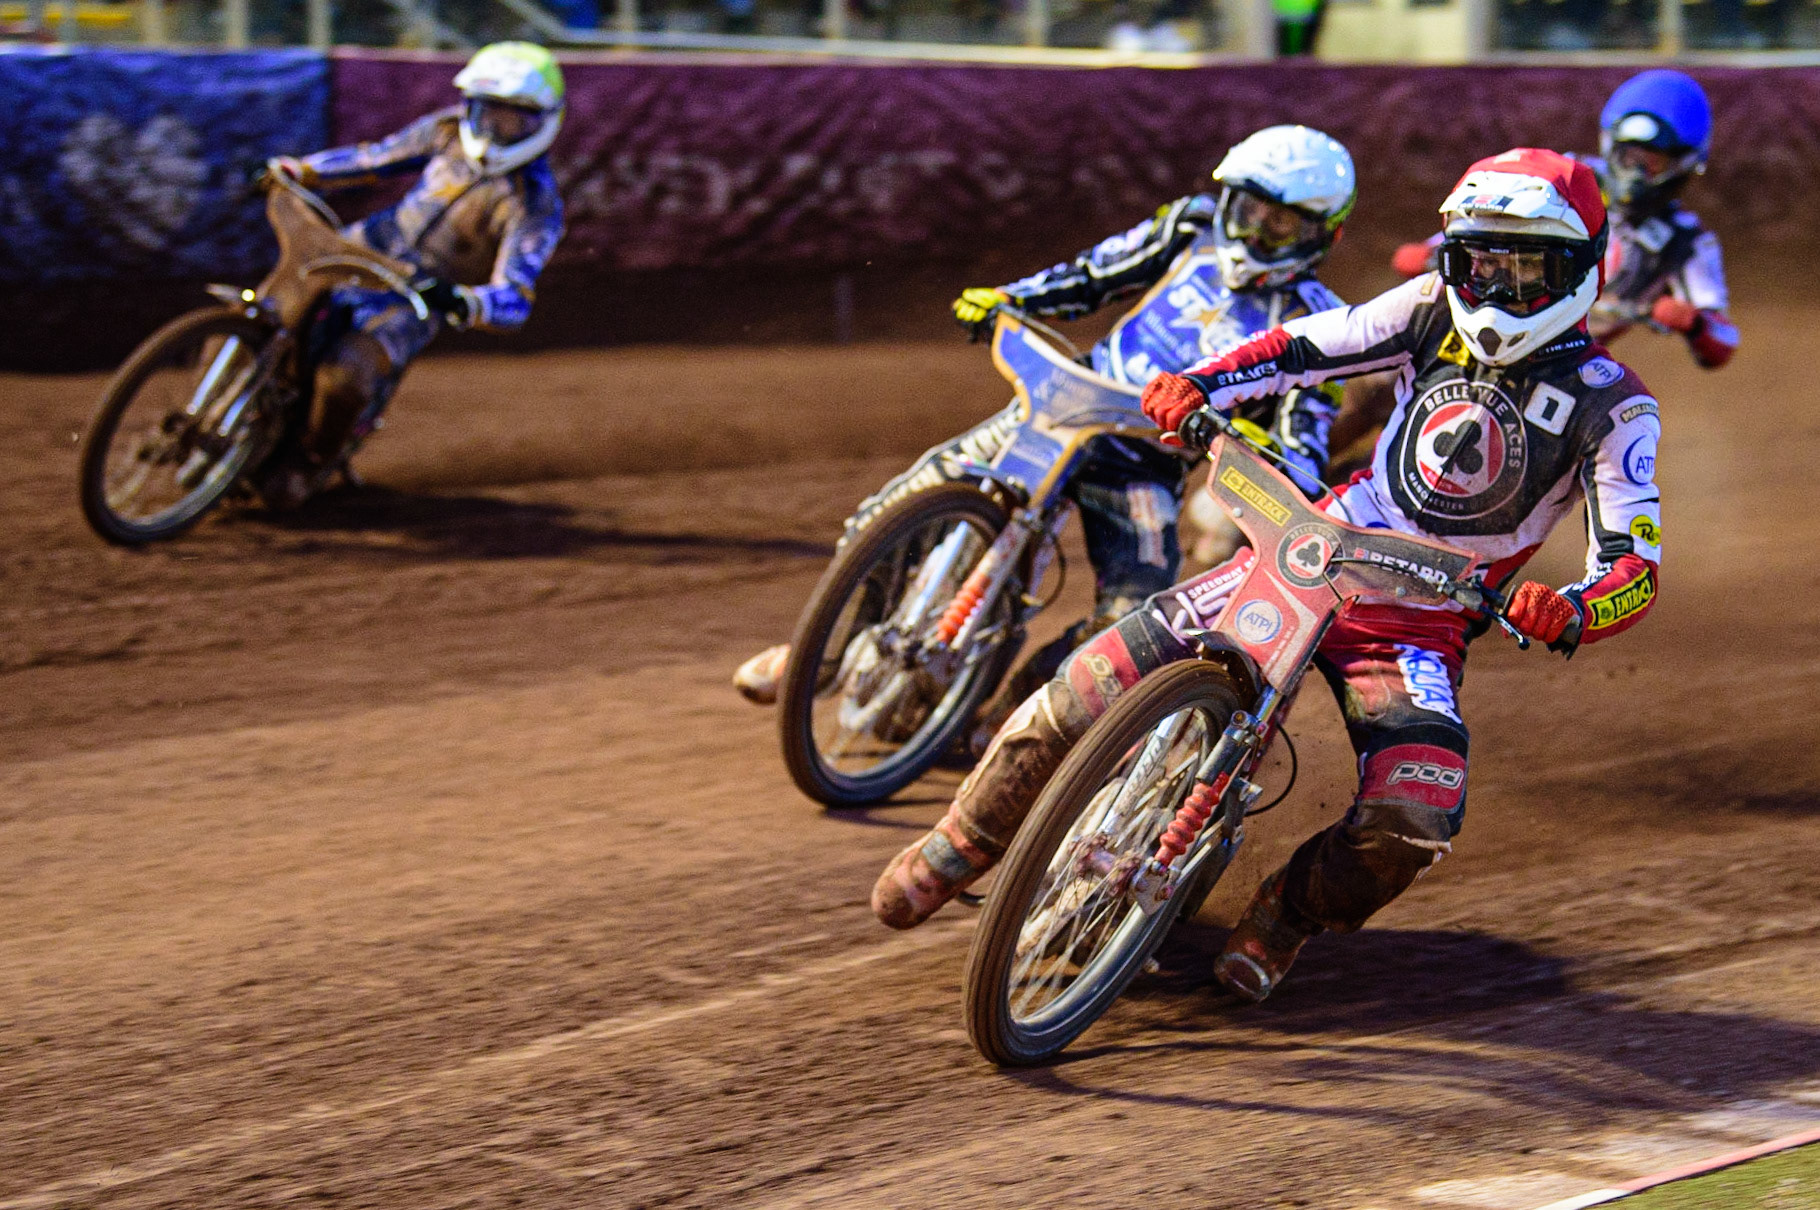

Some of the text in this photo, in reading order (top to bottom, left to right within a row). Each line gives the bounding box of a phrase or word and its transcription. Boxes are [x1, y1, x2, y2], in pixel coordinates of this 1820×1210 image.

[1423, 384, 1523, 468] BELLE VUE ACES
[1187, 565, 1243, 599] SPEEDWAY
[1244, 611, 1273, 632] ATPI
